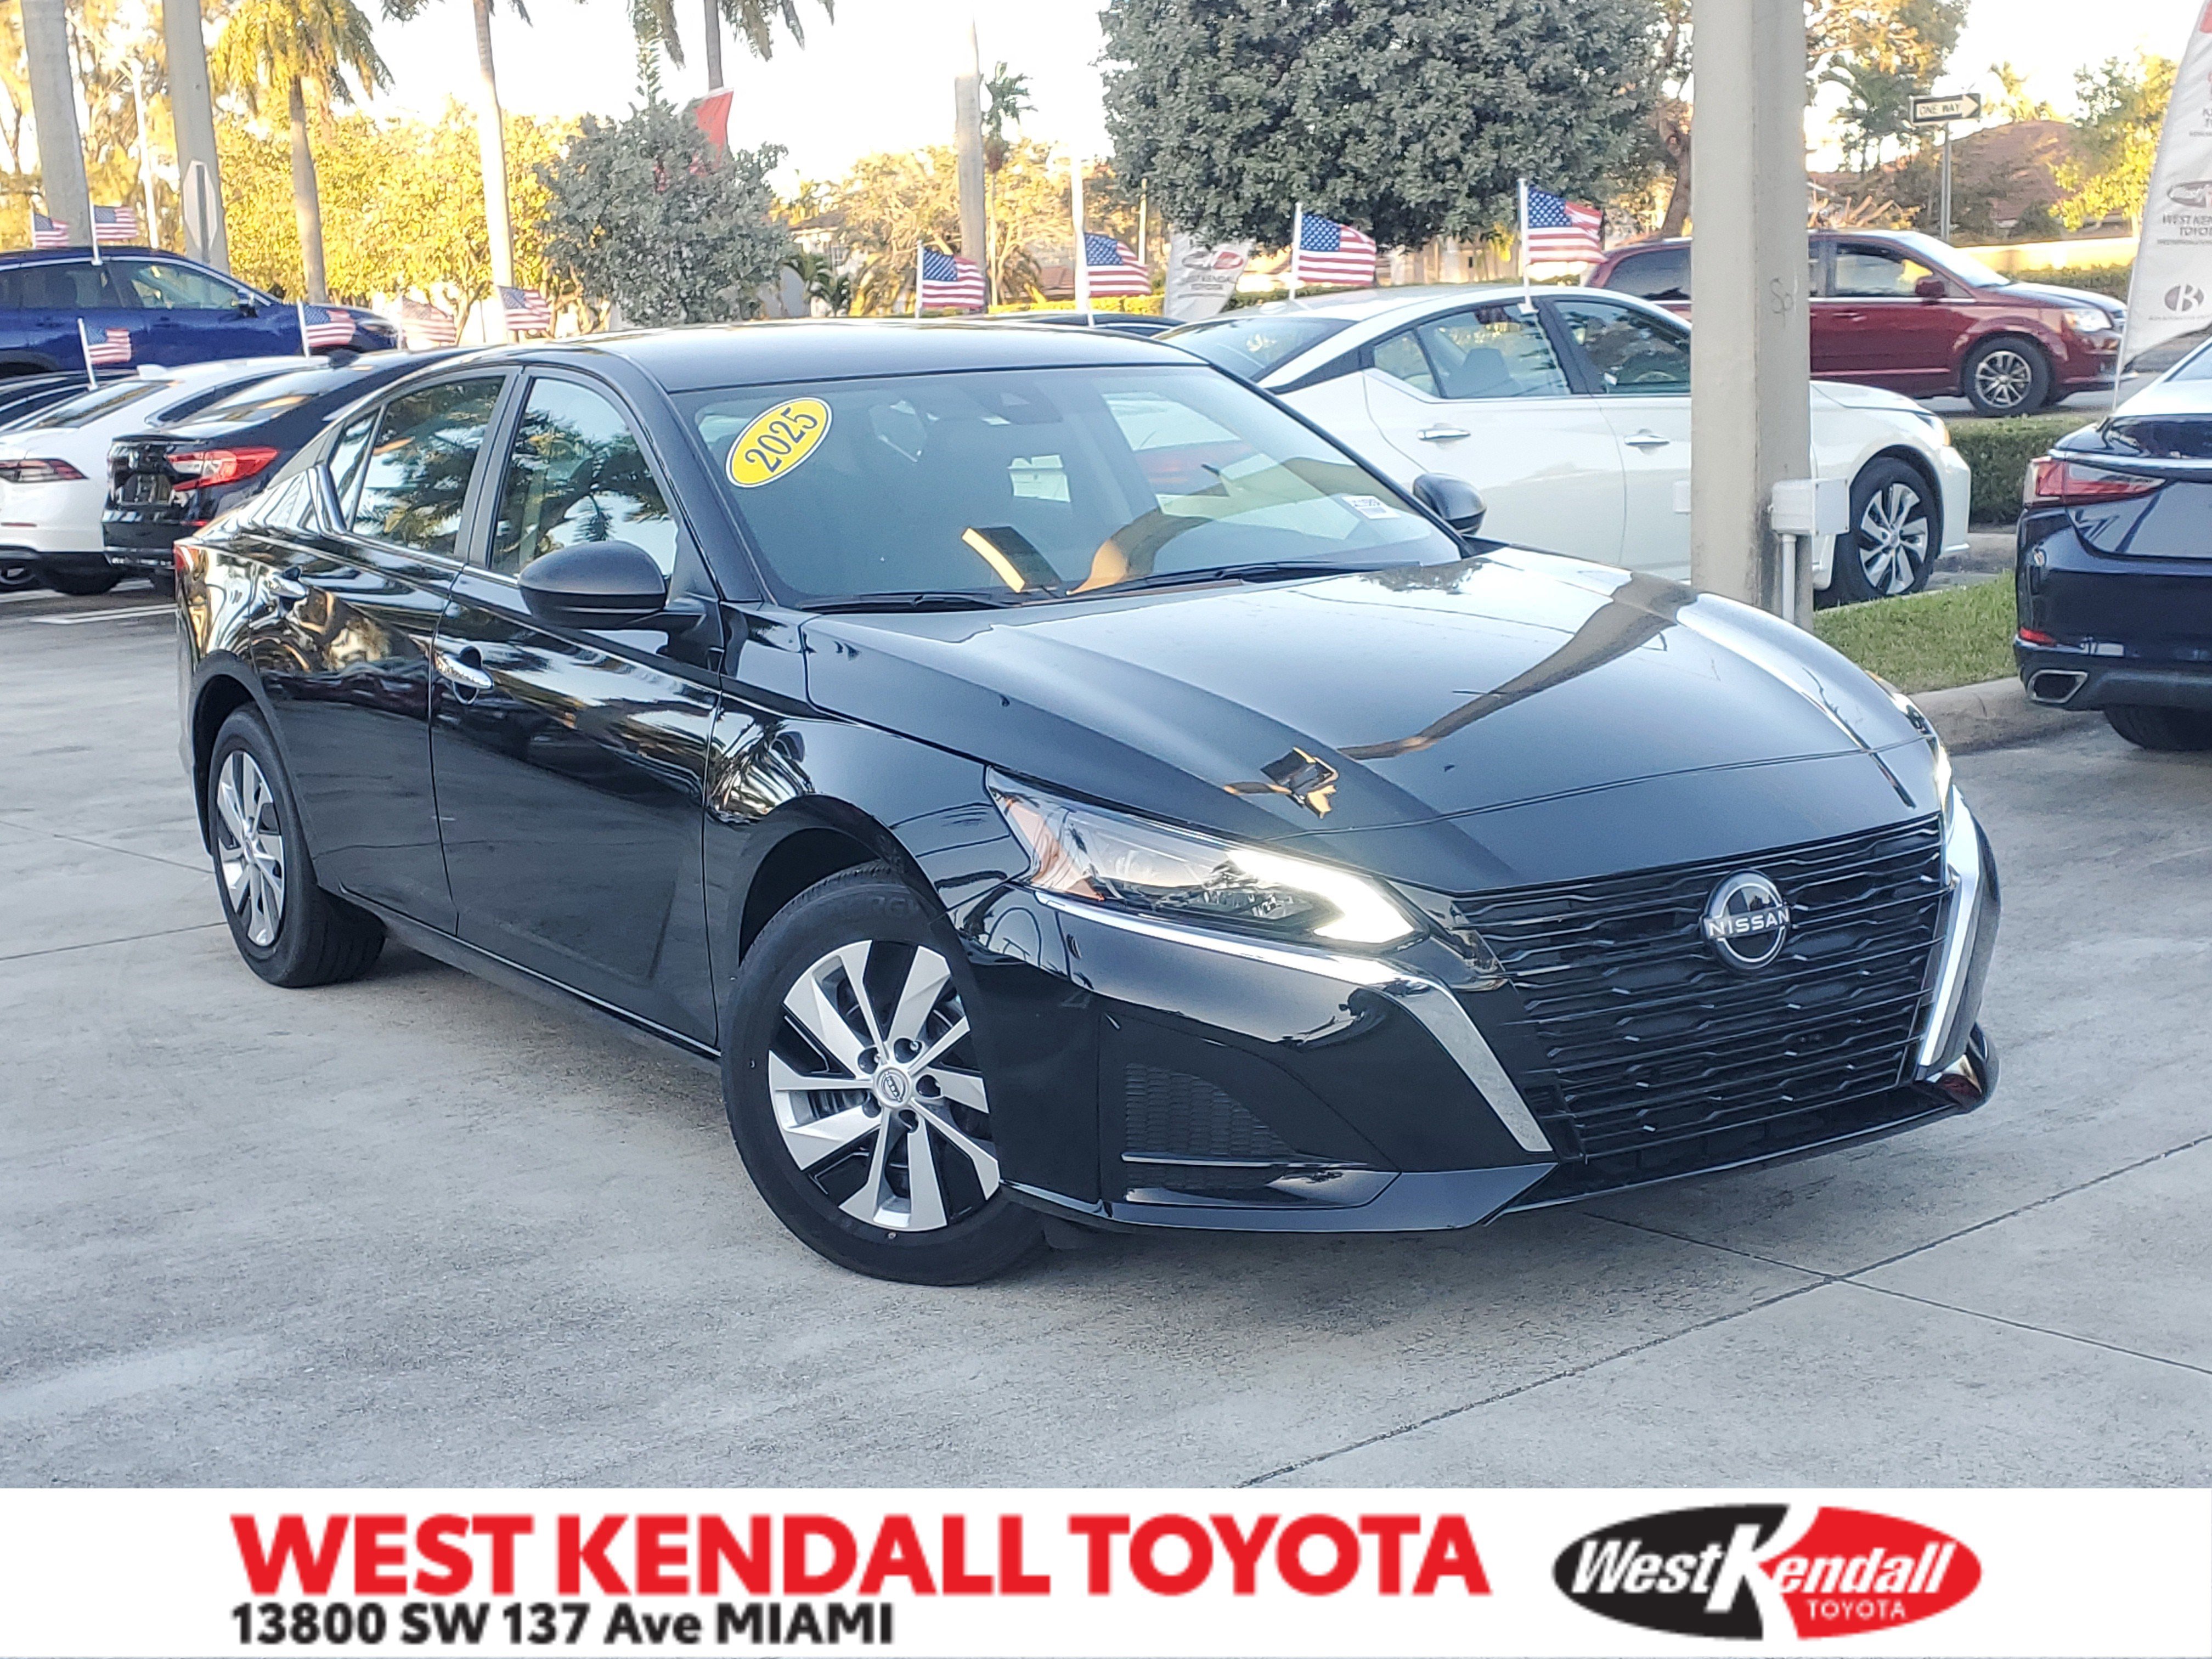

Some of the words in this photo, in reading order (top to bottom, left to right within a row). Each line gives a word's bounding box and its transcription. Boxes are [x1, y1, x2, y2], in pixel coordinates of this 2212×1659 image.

[1920, 104, 1939, 115] ONE
[1942, 102, 1961, 113] WAY
[744, 407, 818, 473] 2025
[1709, 908, 1790, 936] NISSAN
